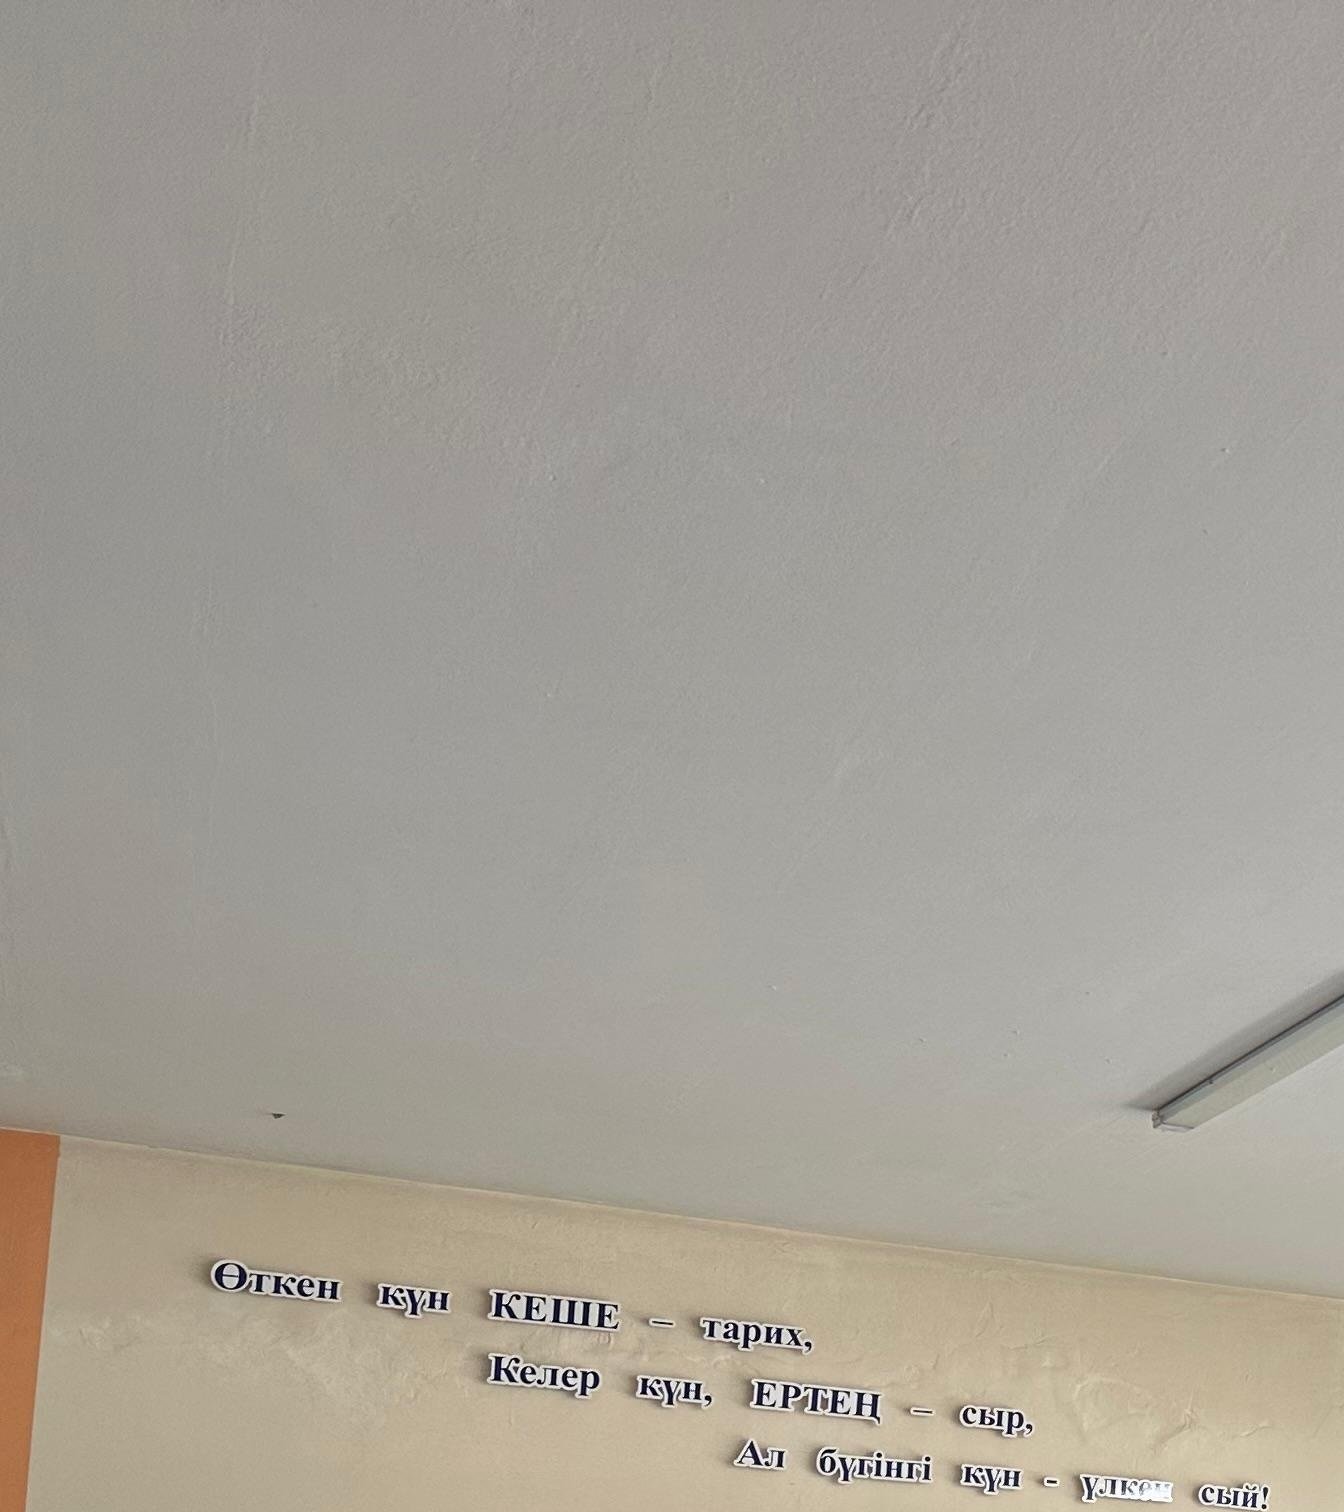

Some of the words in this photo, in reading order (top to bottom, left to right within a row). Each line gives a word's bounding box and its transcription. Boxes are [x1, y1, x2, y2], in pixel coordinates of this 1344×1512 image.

[212, 1260, 341, 1302] Өткен
[379, 1284, 451, 1318] күн
[491, 1289, 621, 1332] КЕШЕ
[702, 1315, 813, 1353] тарих,
[490, 1353, 602, 1399] Келер
[637, 1375, 714, 1408] күн,
[750, 1379, 883, 1425] ЕРТЕҢ
[960, 1405, 1035, 1437] сыр,
[735, 1439, 787, 1470] Ал
[817, 1447, 933, 1484] бүгінгі
[962, 1465, 1023, 1495] күн
[1199, 1482, 1271, 1512] сый!
